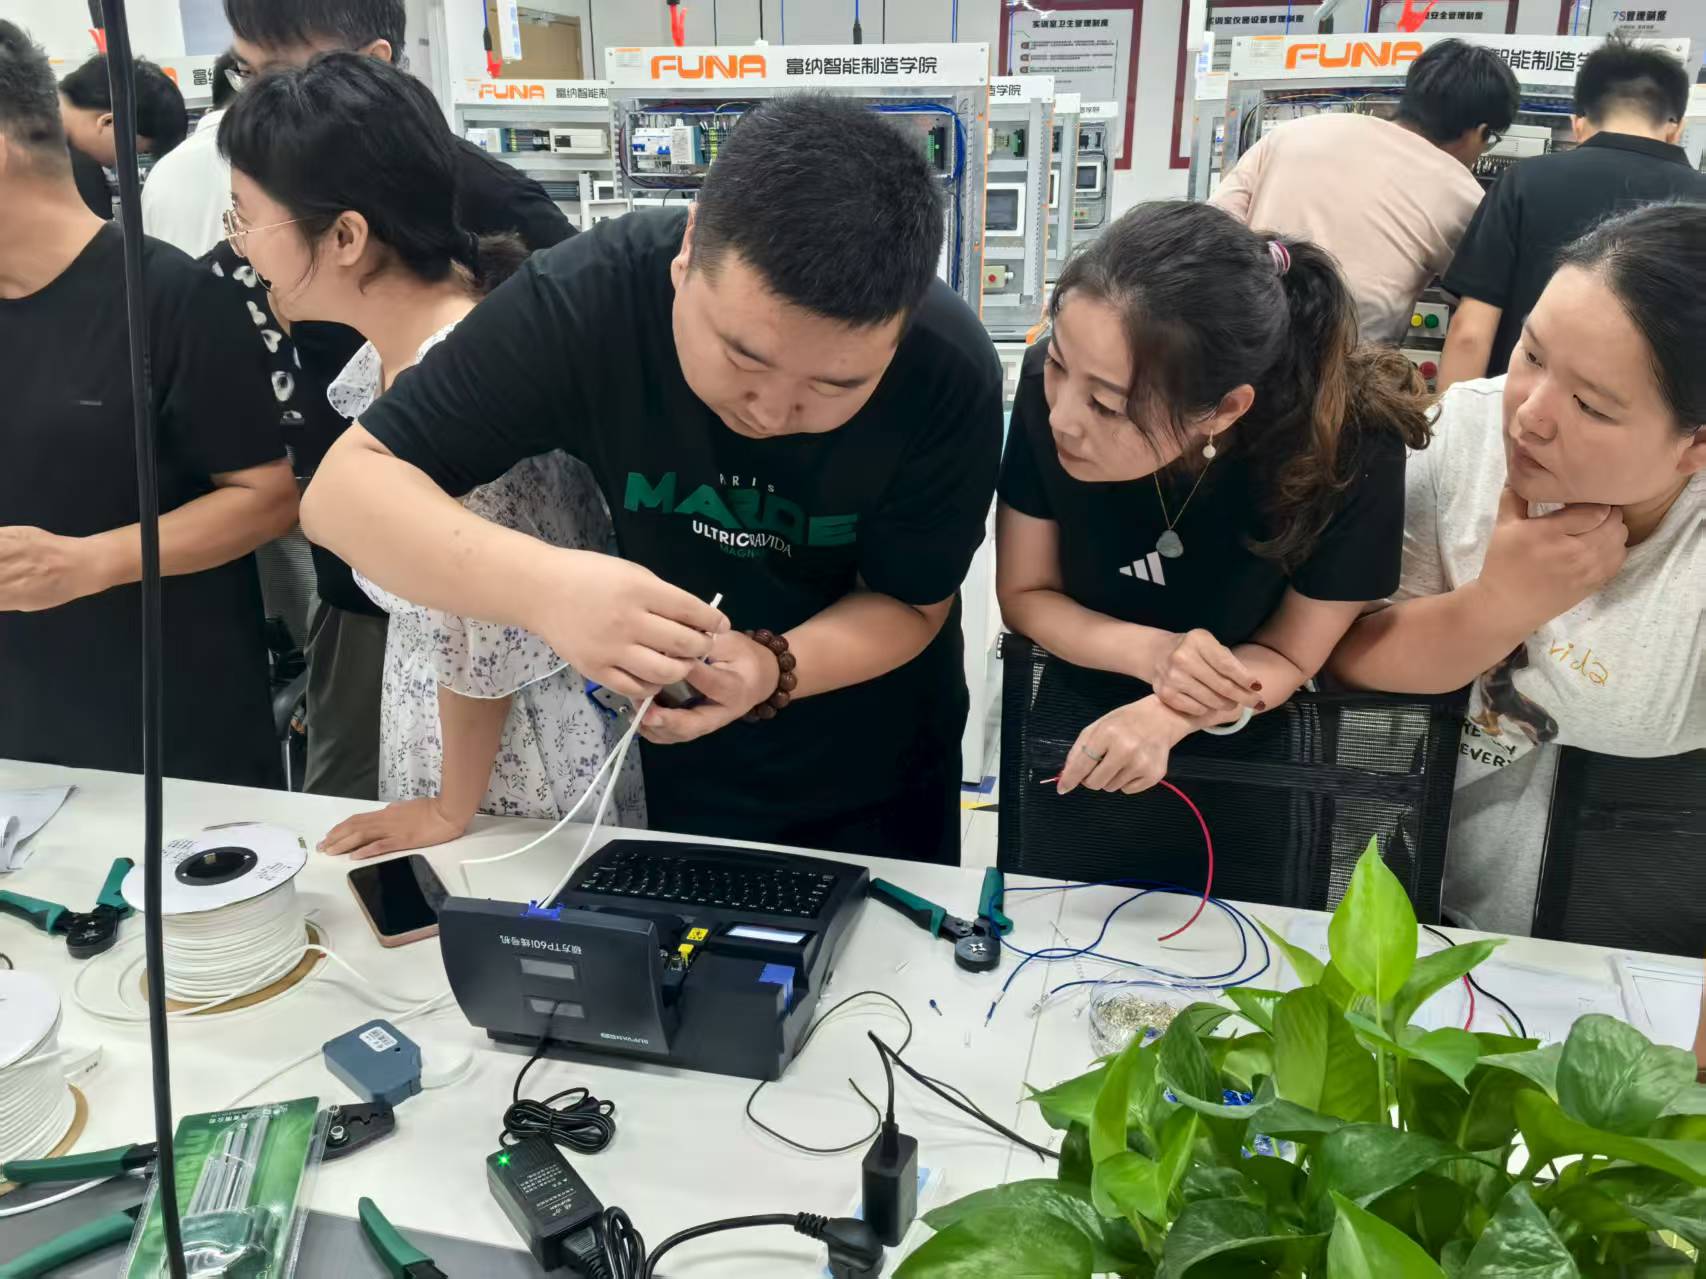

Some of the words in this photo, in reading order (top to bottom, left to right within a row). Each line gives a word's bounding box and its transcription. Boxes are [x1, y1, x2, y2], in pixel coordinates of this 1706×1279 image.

[786, 56, 938, 75] 富纳智能制造学院
[1285, 41, 1423, 69] FUNA
[651, 55, 767, 79] FUNA
[479, 84, 545, 99] FUNA
